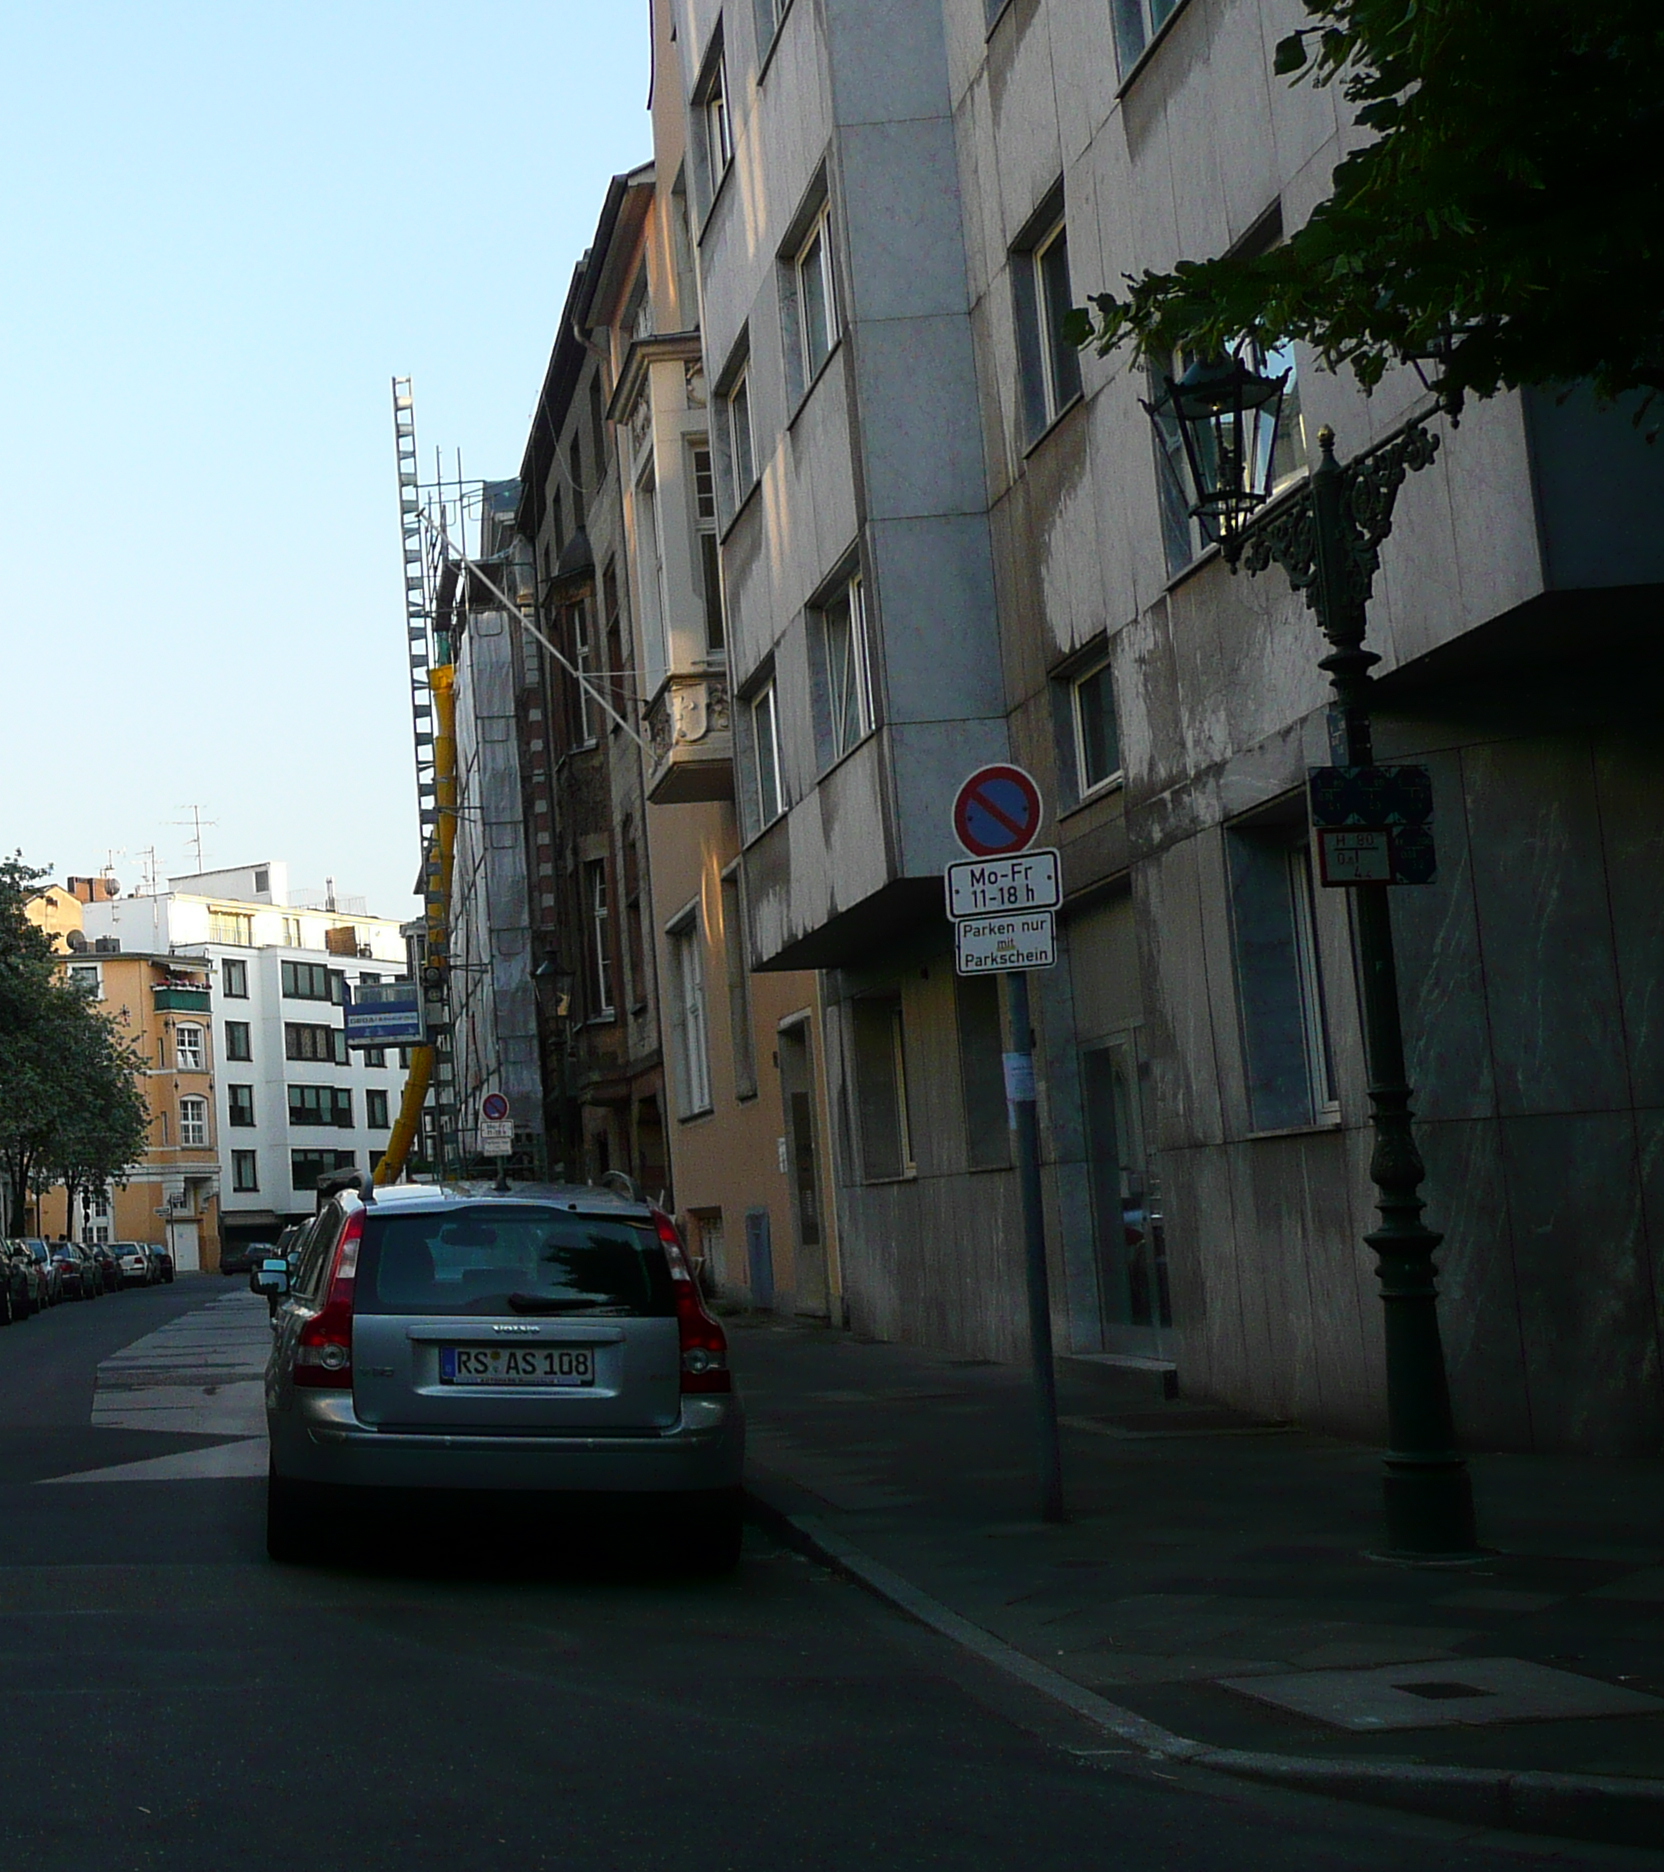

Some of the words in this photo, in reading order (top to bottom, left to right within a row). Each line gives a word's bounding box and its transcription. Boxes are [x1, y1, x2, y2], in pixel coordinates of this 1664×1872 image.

[1335, 834, 1346, 846] H
[1356, 833, 1374, 846] 80
[970, 863, 1033, 887] Mo-Fr
[972, 886, 1018, 908] 11-18
[1025, 883, 1035, 902] h
[963, 921, 1015, 938] Parken
[1021, 919, 1047, 932] nur
[997, 938, 1015, 949] mit
[965, 946, 1048, 968] Parkschein
[456, 1350, 489, 1375] RS
[505, 1351, 537, 1376] AS
[543, 1352, 589, 1376] 108
